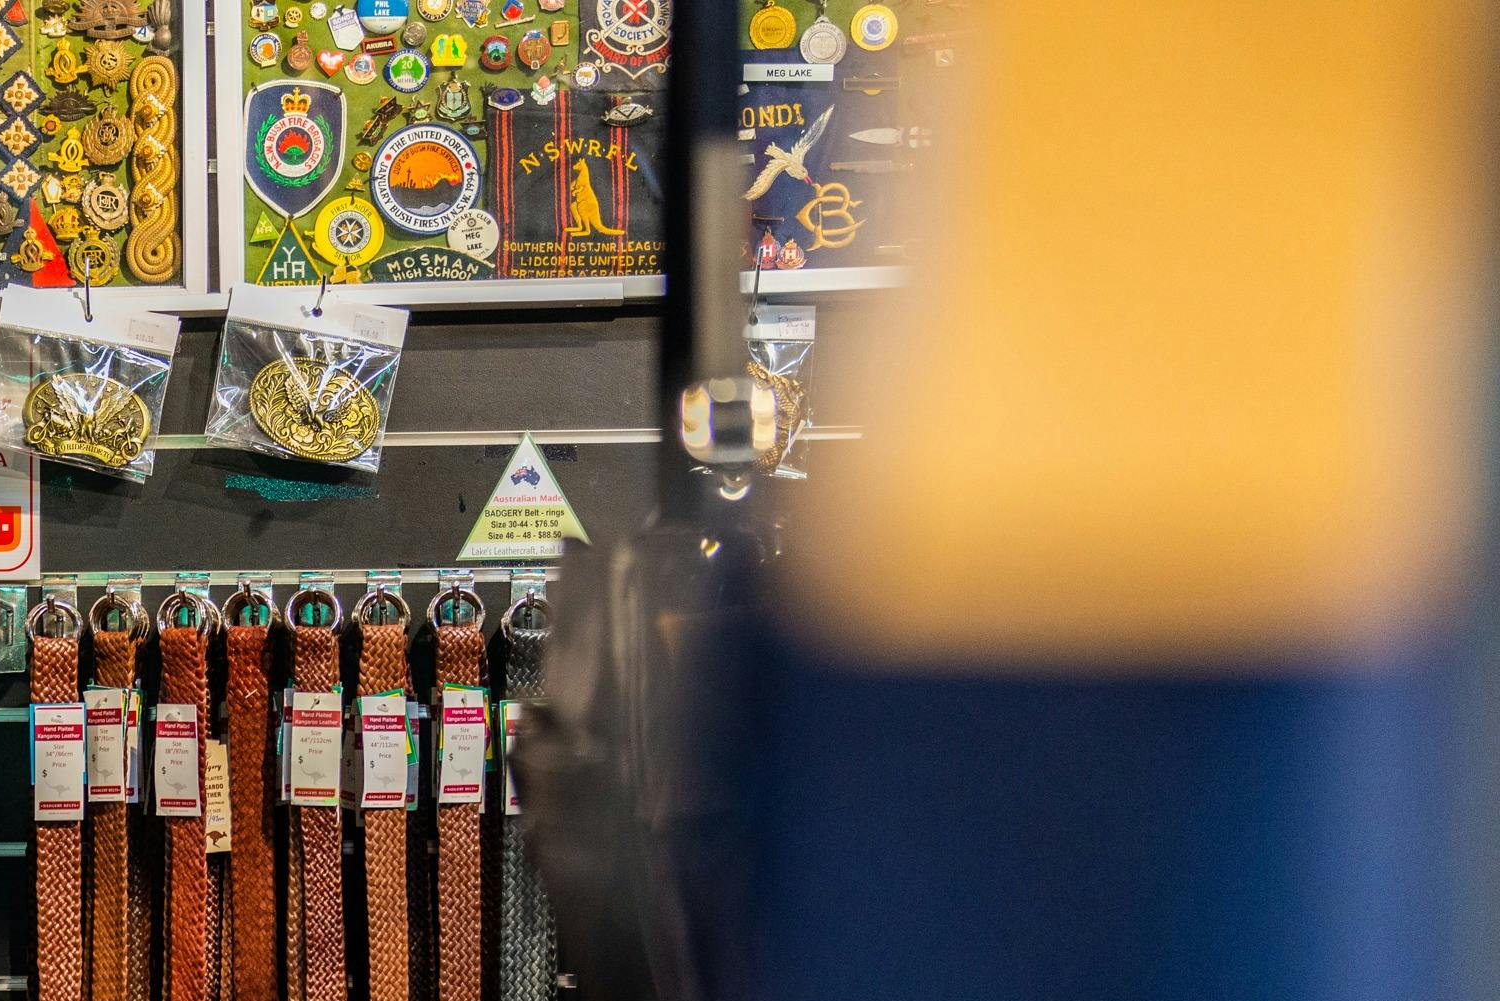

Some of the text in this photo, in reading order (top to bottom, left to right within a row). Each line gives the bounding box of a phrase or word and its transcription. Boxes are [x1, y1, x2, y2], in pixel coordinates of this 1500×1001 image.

[375, 0, 389, 8] PHIL
[614, 27, 655, 40] SOCIETY
[402, 60, 413, 69] 20
[630, 56, 643, 66] OF
[767, 69, 812, 77] MEG LAKE
[267, 116, 323, 171] BUSH FIRE BRIGADES
[389, 131, 470, 161] THE UNITED FORCE
[426, 145, 439, 153] FIRE
[378, 161, 392, 207] JANUARY
[389, 204, 412, 225] BUSH
[414, 217, 440, 228] FIRES
[442, 214, 451, 225] IN
[451, 212, 492, 231] ROTARY CLUB
[465, 232, 480, 240] MEG
[467, 242, 482, 250] LAKE
[504, 240, 563, 253] SOUTHERN
[387, 254, 479, 274] MOSMAN
[520, 256, 585, 266] LIDCOMBE
[590, 256, 634, 266] UNITED
[393, 266, 472, 281] HIGH SCHOOL
[493, 495, 537, 503] Australian
[524, 509, 539, 517] Belt
[491, 521, 506, 529] Size
[535, 520, 559, 528] $76.50
[488, 532, 503, 540] Size
[538, 531, 562, 539] $88.50
[471, 547, 492, 556] Lake's
[494, 546, 538, 555] Leathercraft,
